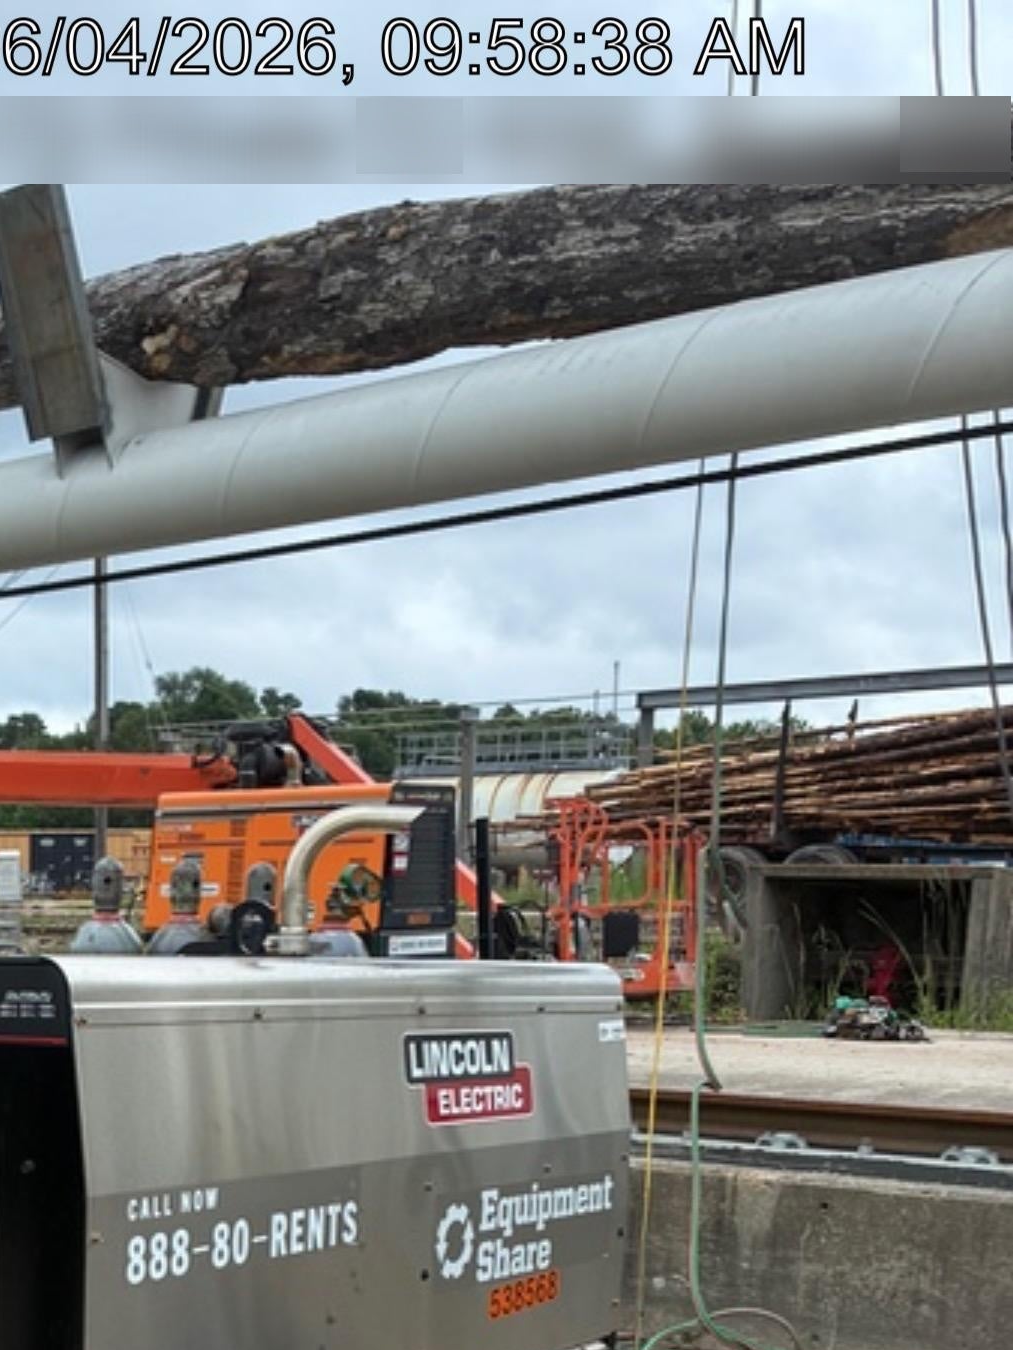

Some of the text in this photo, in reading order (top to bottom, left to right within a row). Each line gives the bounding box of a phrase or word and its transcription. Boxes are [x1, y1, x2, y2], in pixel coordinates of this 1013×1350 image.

[408, 1037, 511, 1078] LINCOLN
[438, 1083, 524, 1117] ELECTRIC
[126, 1187, 220, 1222] CALL NOW
[478, 1174, 614, 1236] Equipment
[125, 1200, 358, 1285] 888-80-RENTS
[475, 1238, 552, 1283] Share
[488, 1271, 560, 1320] 538568
